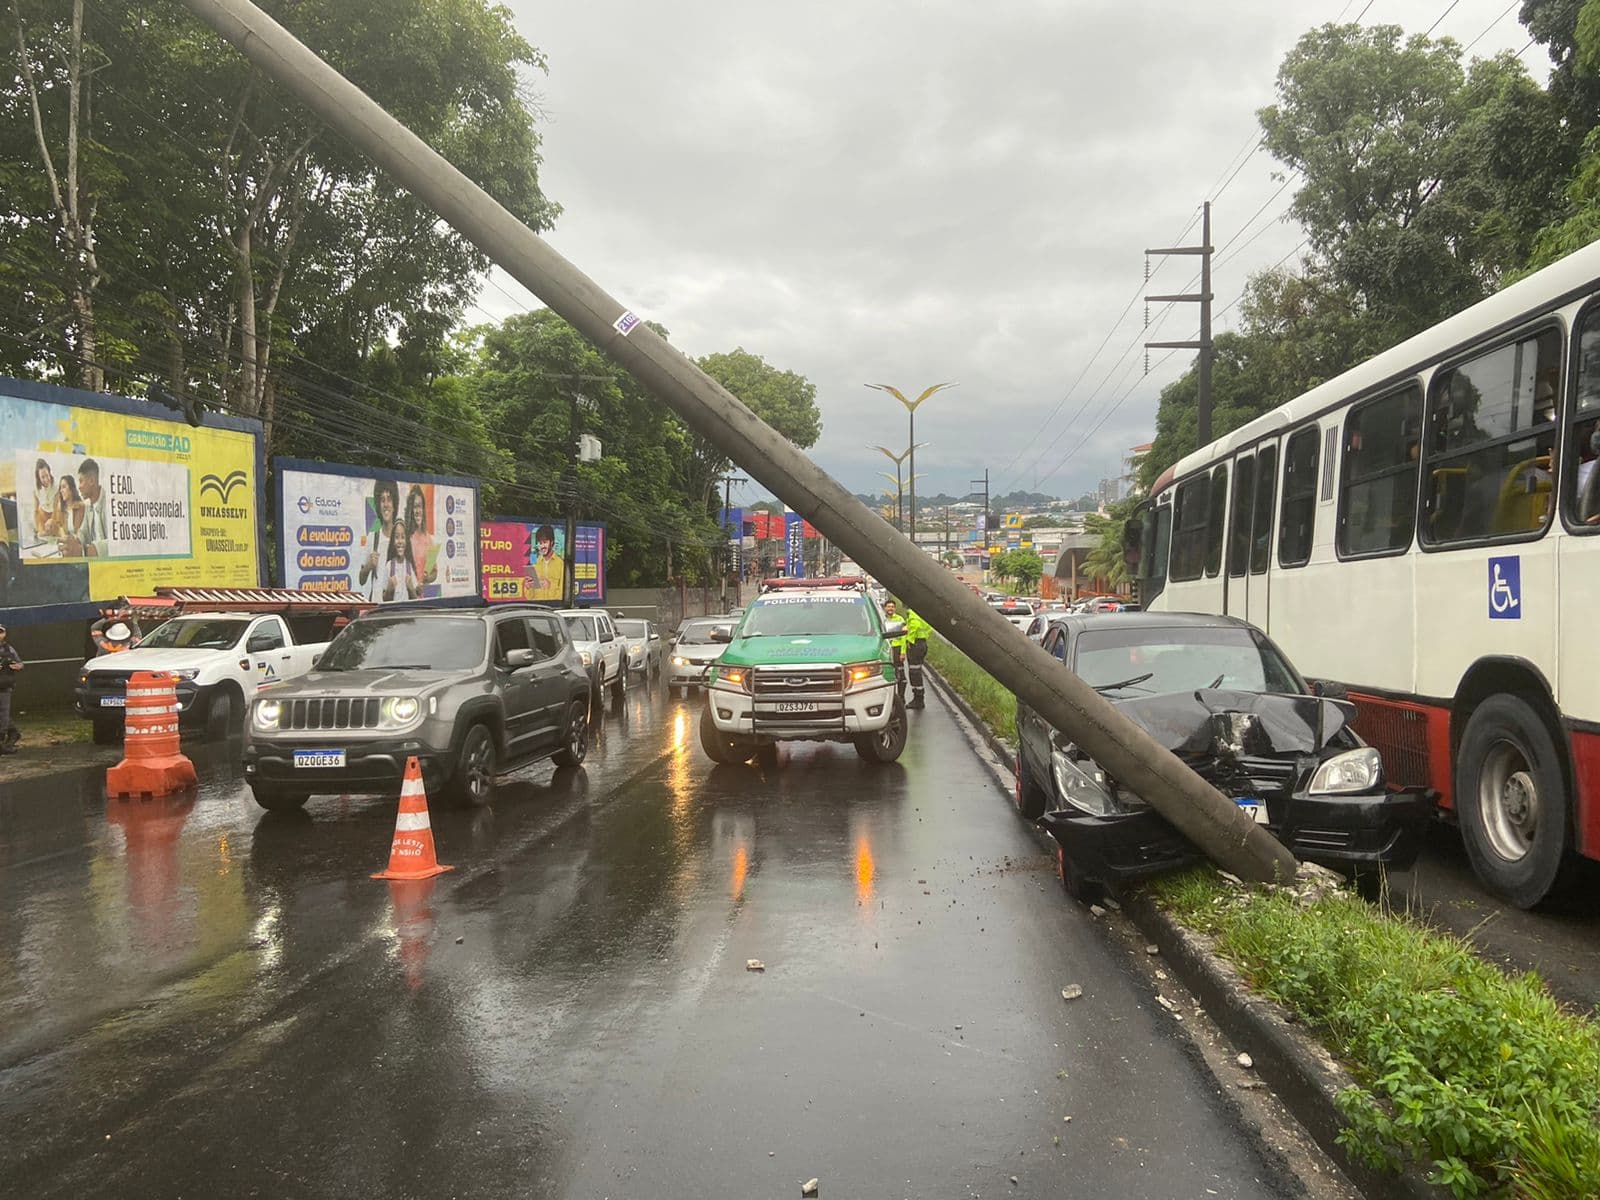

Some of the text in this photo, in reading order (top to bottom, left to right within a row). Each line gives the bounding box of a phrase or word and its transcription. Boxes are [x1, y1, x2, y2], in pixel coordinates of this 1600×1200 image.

[117, 475, 135, 495] EAD.
[117, 499, 185, 519] semipresencial.
[200, 506, 247, 520] UNIASSELVI
[120, 521, 131, 540] do
[131, 523, 147, 540] seu
[300, 528, 351, 546] A evolução
[300, 552, 347, 567] do ensino
[302, 576, 349, 592] municipal
[493, 582, 518, 594] 189
